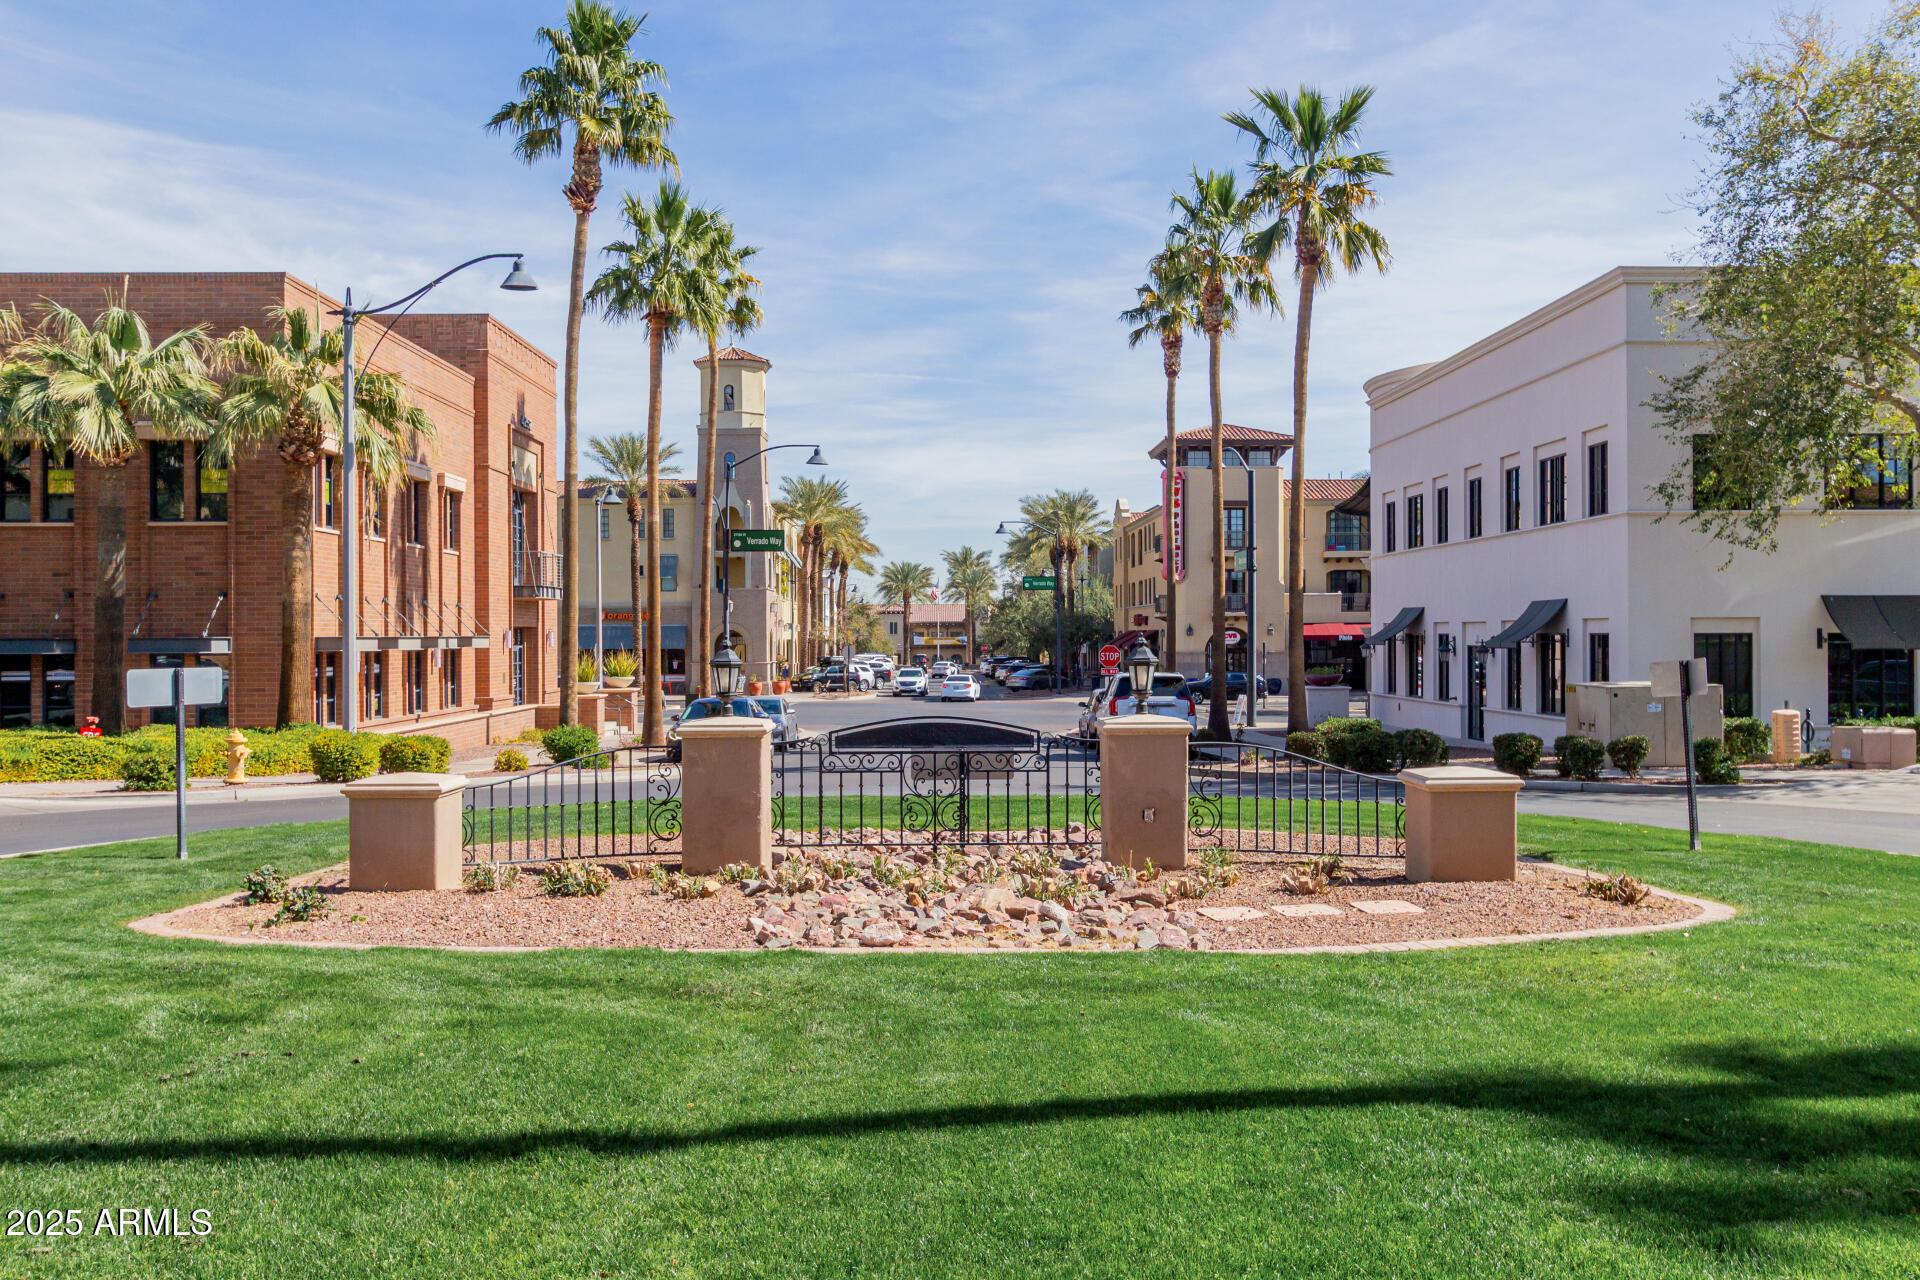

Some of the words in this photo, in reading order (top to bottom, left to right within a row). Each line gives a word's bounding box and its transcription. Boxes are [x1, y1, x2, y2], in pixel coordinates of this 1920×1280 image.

[747, 537, 768, 545] Verrado
[770, 537, 782, 547] Way
[607, 612, 637, 621] orang
[1101, 652, 1119, 660] STOP
